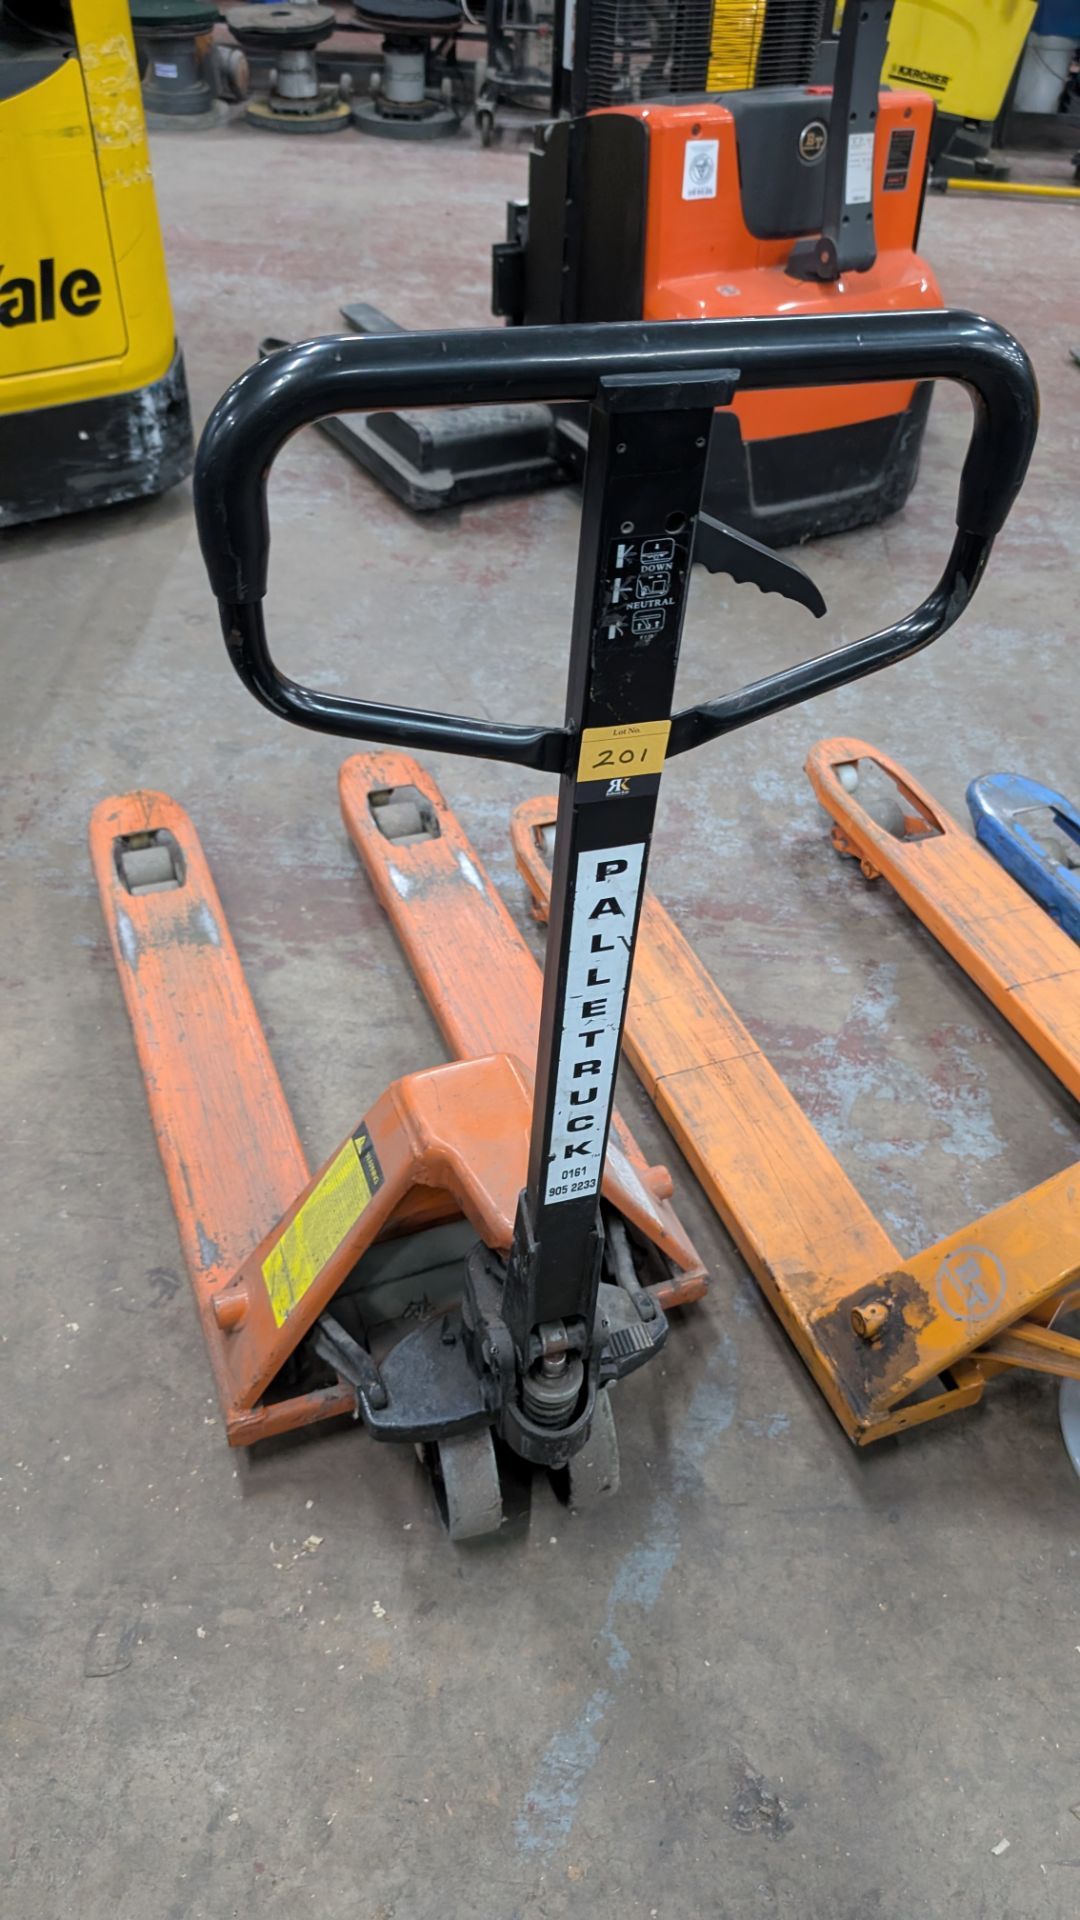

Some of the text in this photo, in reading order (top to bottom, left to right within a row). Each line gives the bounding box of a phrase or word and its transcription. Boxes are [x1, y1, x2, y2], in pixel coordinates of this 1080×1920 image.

[0, 258, 102, 329] ale
[641, 562, 673, 573] DOWN
[626, 597, 675, 610] NEUTRAL
[612, 728, 627, 736] Lot
[592, 748, 648, 769] 201
[564, 859, 629, 1159] PALLETRUCK
[562, 1166, 587, 1180] 0161
[549, 1179, 596, 1197] 905 2233
